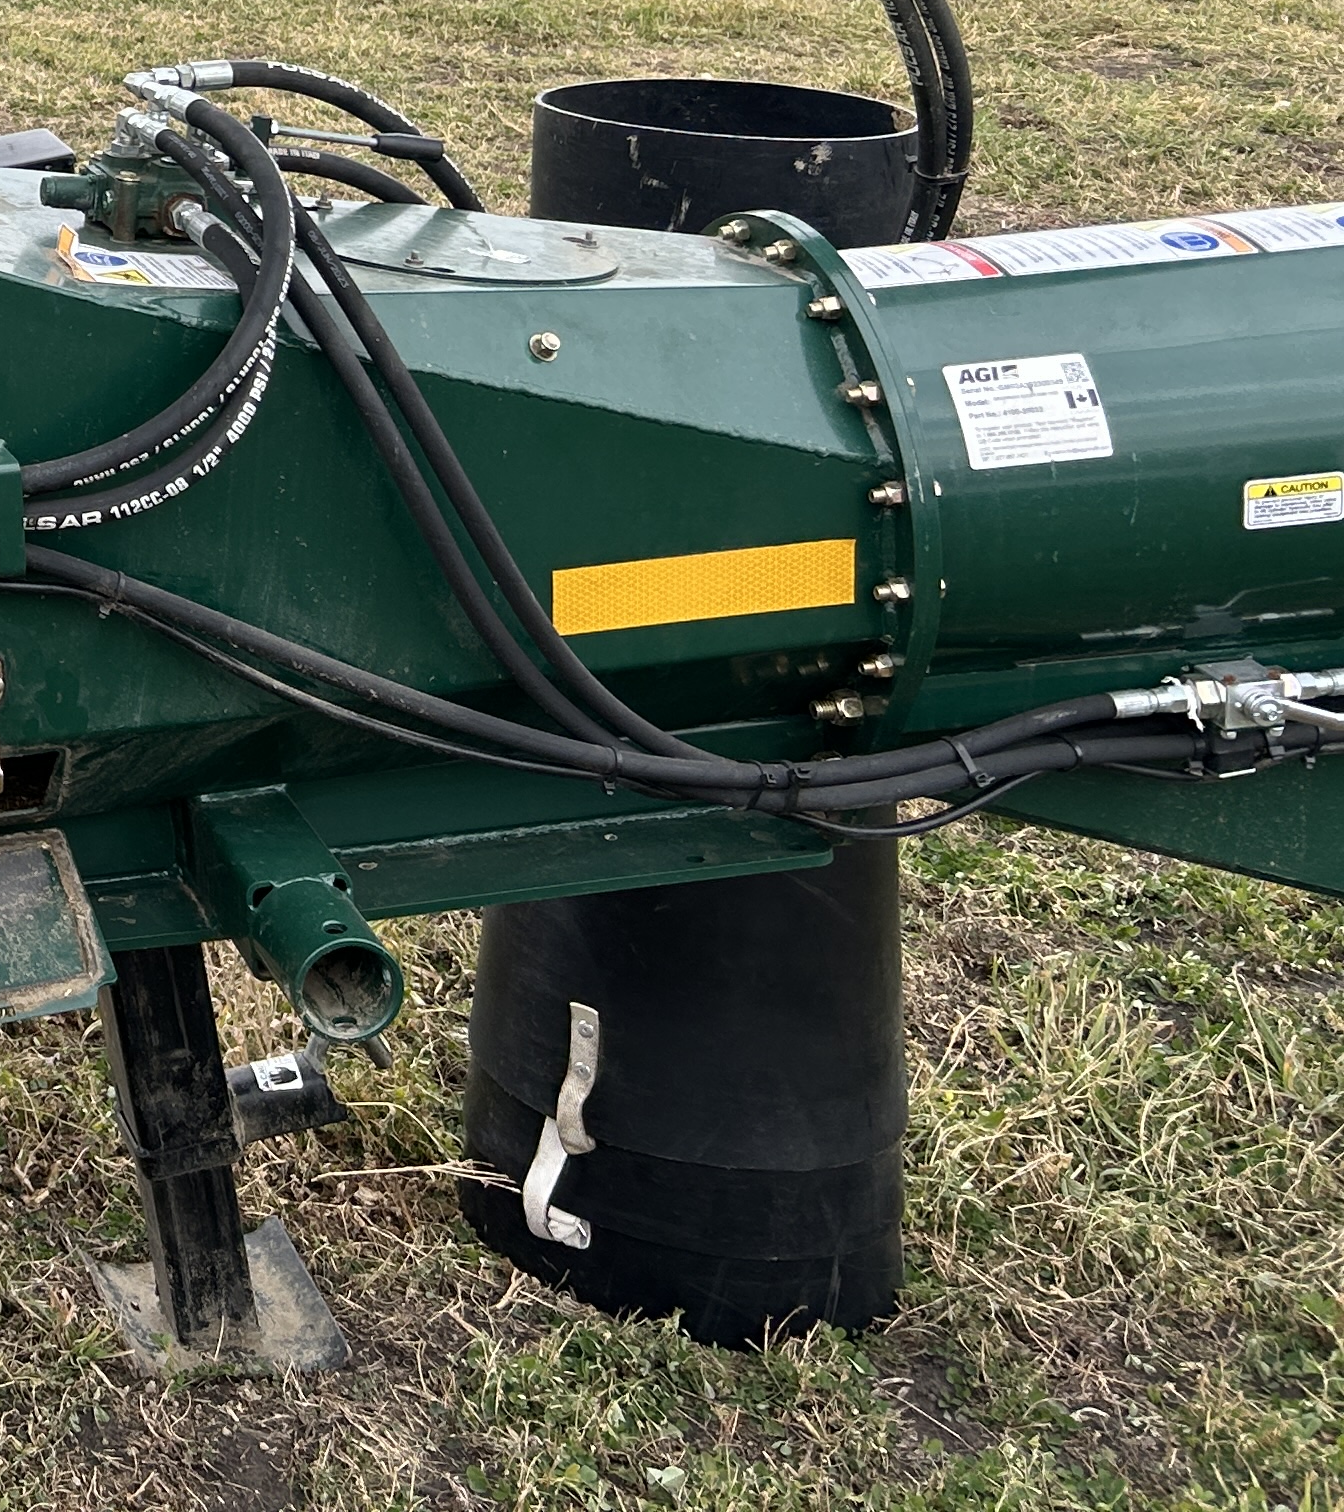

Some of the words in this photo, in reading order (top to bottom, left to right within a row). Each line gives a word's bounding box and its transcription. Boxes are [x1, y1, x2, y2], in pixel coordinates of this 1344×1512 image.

[955, 366, 1000, 384] AGI
[110, 476, 190, 519] 112CC-08
[192, 445, 224, 477] 1/2"
[250, 371, 270, 402] PSI
[1280, 480, 1328, 493] CAUTION
